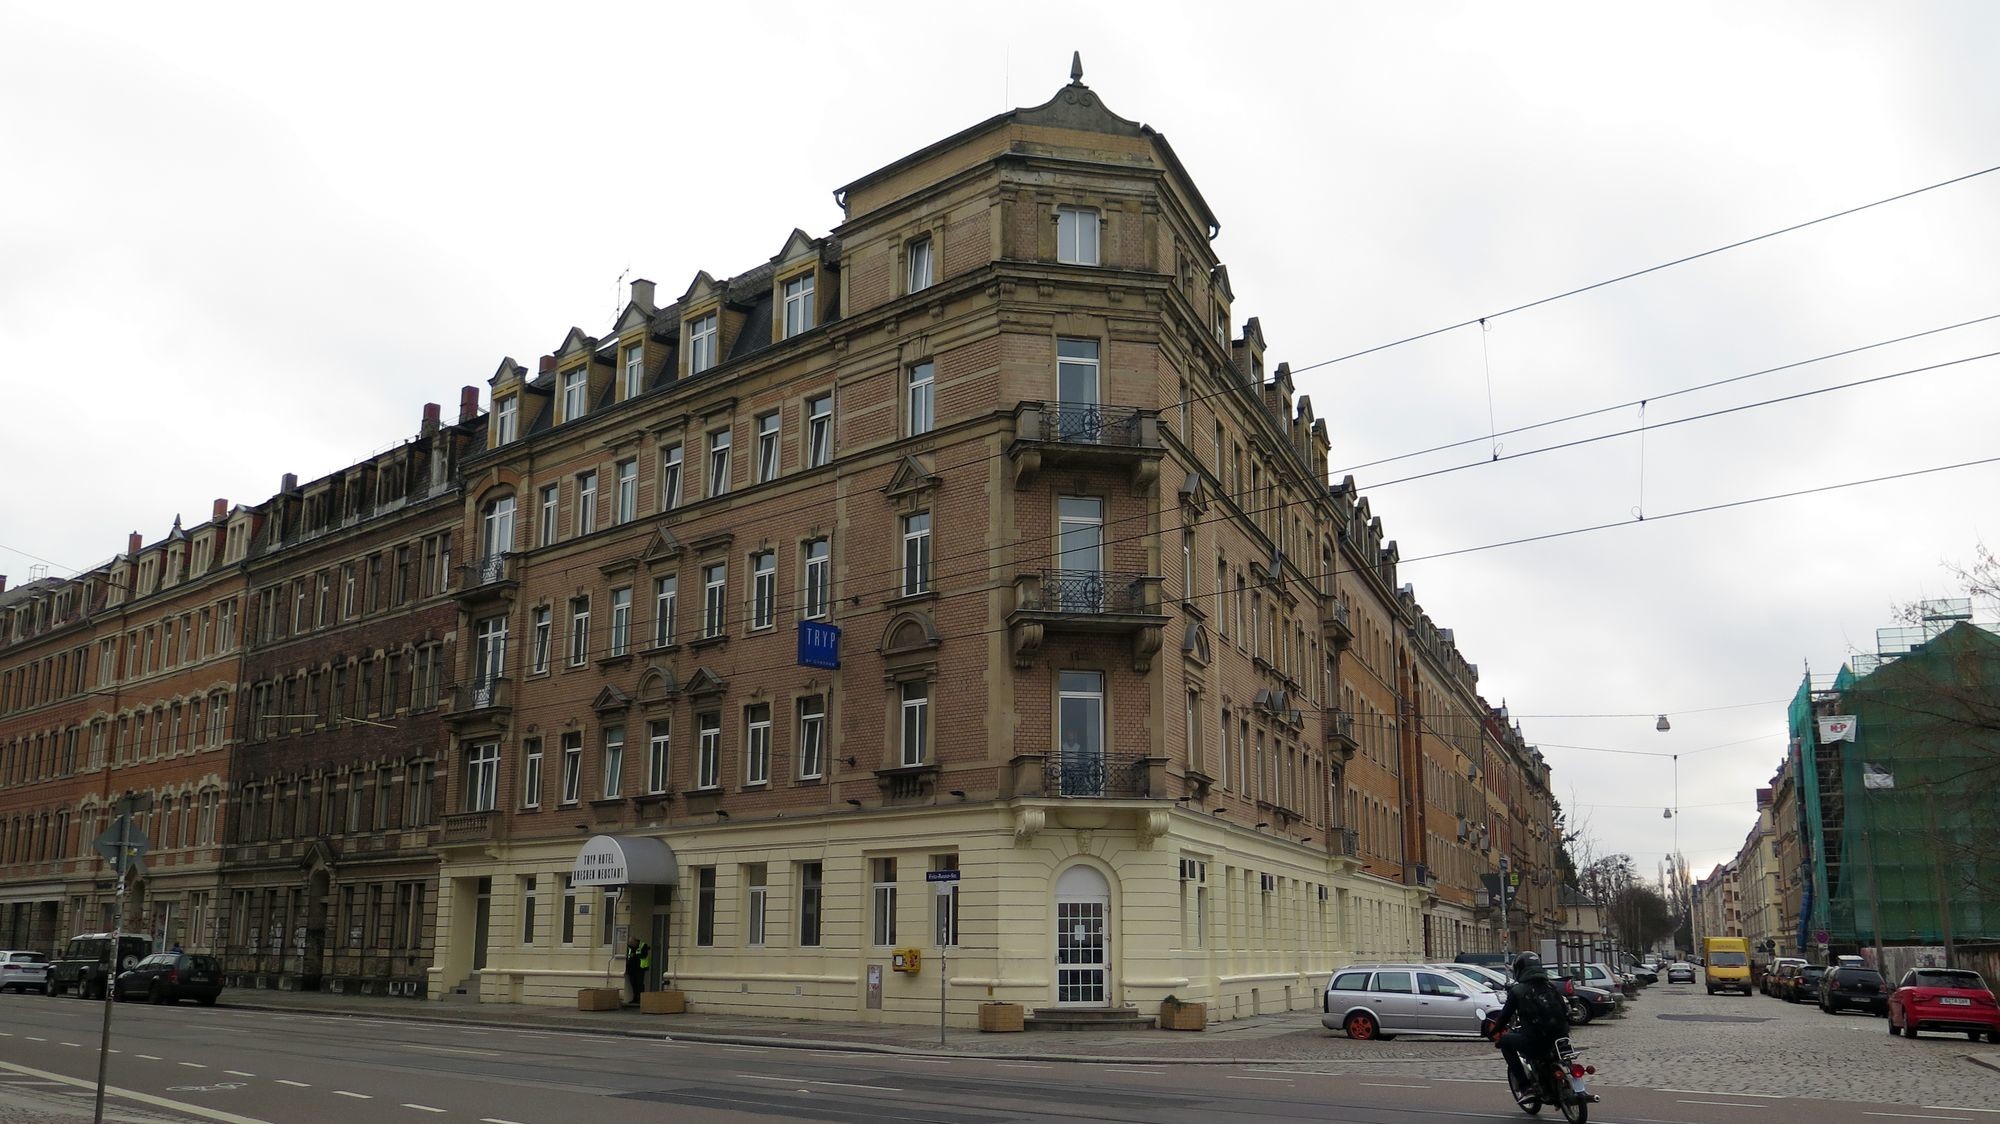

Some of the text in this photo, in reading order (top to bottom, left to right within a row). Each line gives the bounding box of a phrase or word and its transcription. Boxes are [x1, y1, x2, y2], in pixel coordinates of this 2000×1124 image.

[807, 628, 836, 649] TRYP
[584, 853, 614, 865] TRYP HOTEL
[573, 867, 624, 881] DRESDEN NEUSTADT
